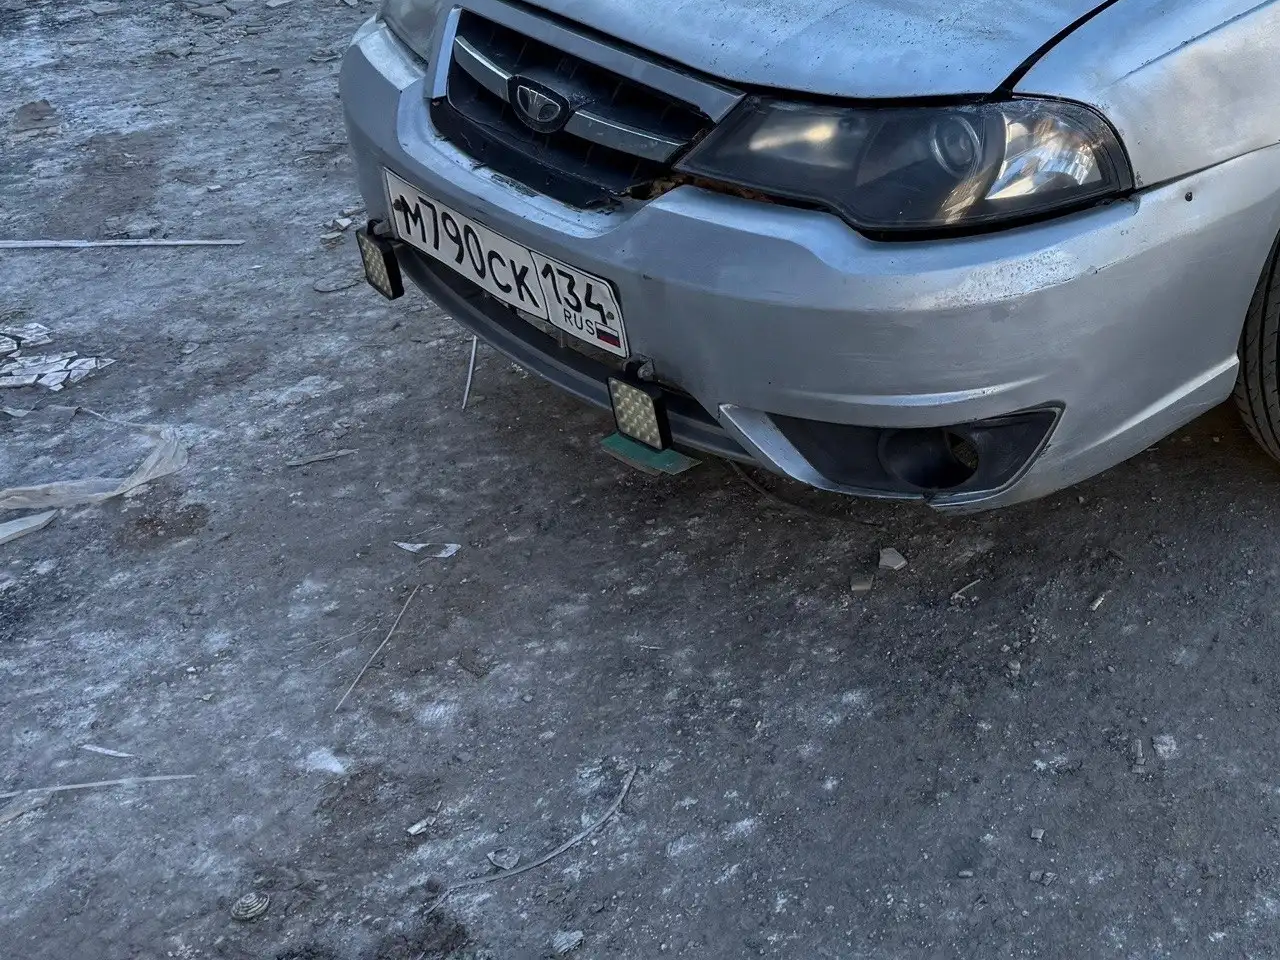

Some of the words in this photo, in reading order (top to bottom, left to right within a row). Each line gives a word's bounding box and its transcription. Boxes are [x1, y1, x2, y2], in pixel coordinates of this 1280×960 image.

[400, 194, 541, 309] М790СК
[542, 263, 608, 325] 134
[564, 307, 595, 335] RUS
